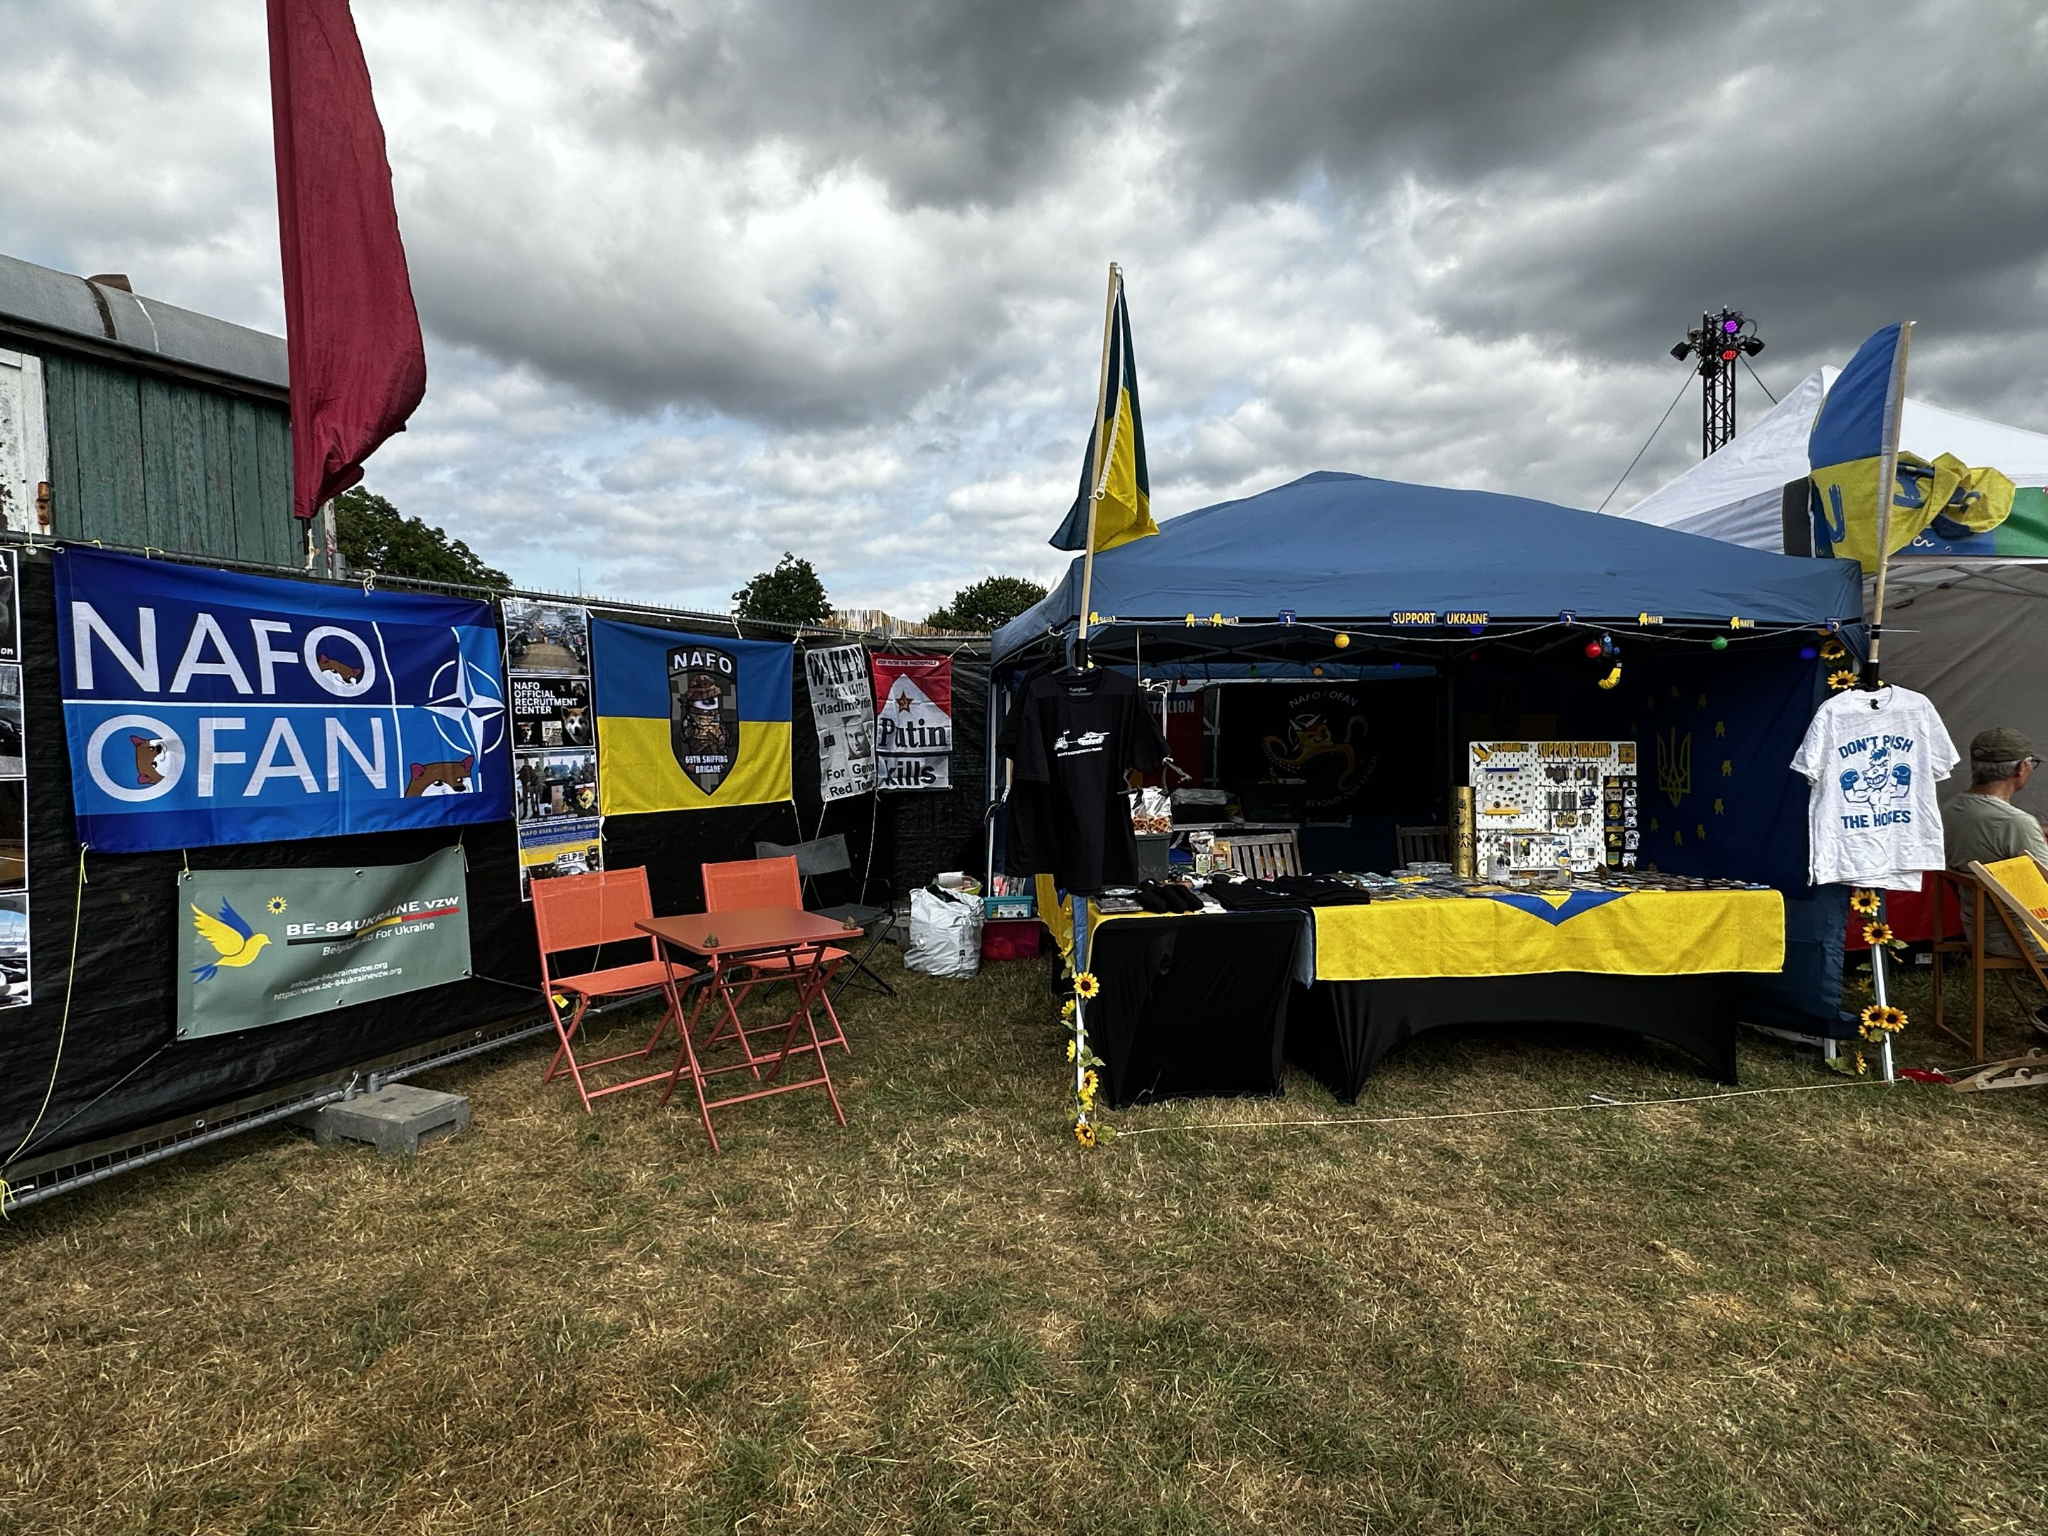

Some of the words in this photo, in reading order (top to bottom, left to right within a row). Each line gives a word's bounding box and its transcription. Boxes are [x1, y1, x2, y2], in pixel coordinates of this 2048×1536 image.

[1393, 613, 1435, 624] SUPPORT
[1447, 613, 1488, 624] UKRAINE
[72, 601, 376, 697] NAFO
[674, 651, 732, 674] NAFO
[514, 682, 540, 690] NAFO
[514, 690, 556, 698] OFFICIAL
[1289, 691, 1320, 708] NAFO
[1329, 691, 1358, 707] OFAN
[515, 698, 578, 706] RECRUITMENT
[515, 706, 552, 715] CENTER
[878, 718, 949, 748] Putin
[1537, 742, 1571, 758] SUPPORT
[1577, 742, 1611, 758] UKRAINE
[1838, 736, 1879, 759] DON'T
[1882, 735, 1913, 752] PSH
[87, 714, 387, 802] OFAN
[685, 755, 701, 764] 69TH
[702, 755, 728, 764] SNIFFING
[696, 765, 721, 774] BRIGADE
[827, 769, 845, 781] For
[882, 760, 937, 787] kills
[829, 782, 852, 797] Red
[1306, 796, 1341, 808] BEYOND
[1841, 815, 1869, 829] THE
[520, 829, 538, 837] NAFO
[557, 852, 578, 863] HELP
[286, 901, 420, 936] BE-84UKRAINE
[375, 928, 392, 939] For
[394, 921, 435, 936] Ukraine
